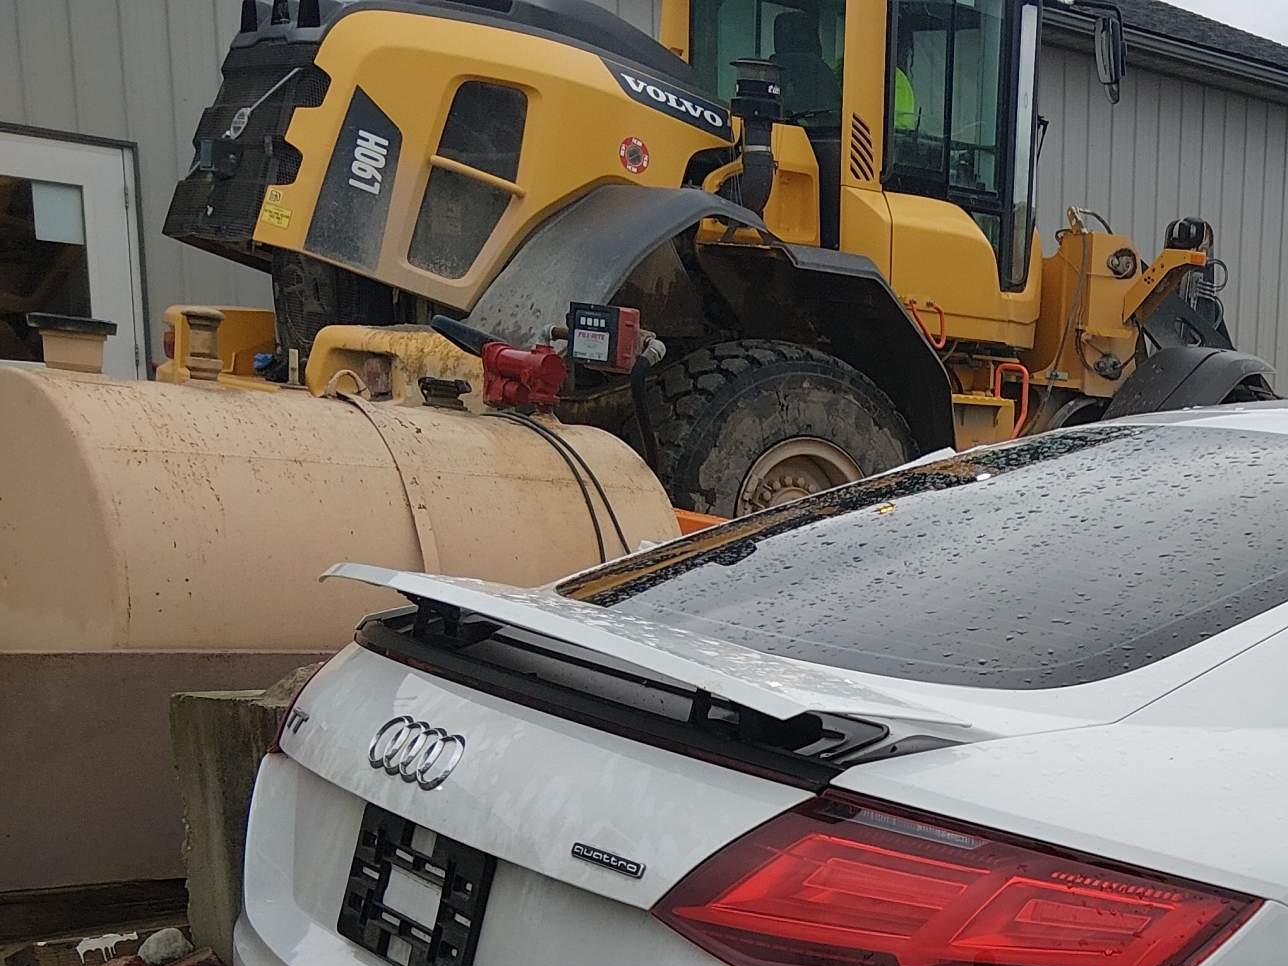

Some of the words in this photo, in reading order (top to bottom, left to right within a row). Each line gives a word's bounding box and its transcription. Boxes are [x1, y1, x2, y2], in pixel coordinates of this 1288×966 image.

[620, 73, 723, 127] VOLVO
[348, 129, 389, 195] L90H
[287, 708, 310, 735] TT
[573, 845, 637, 872] quattro
